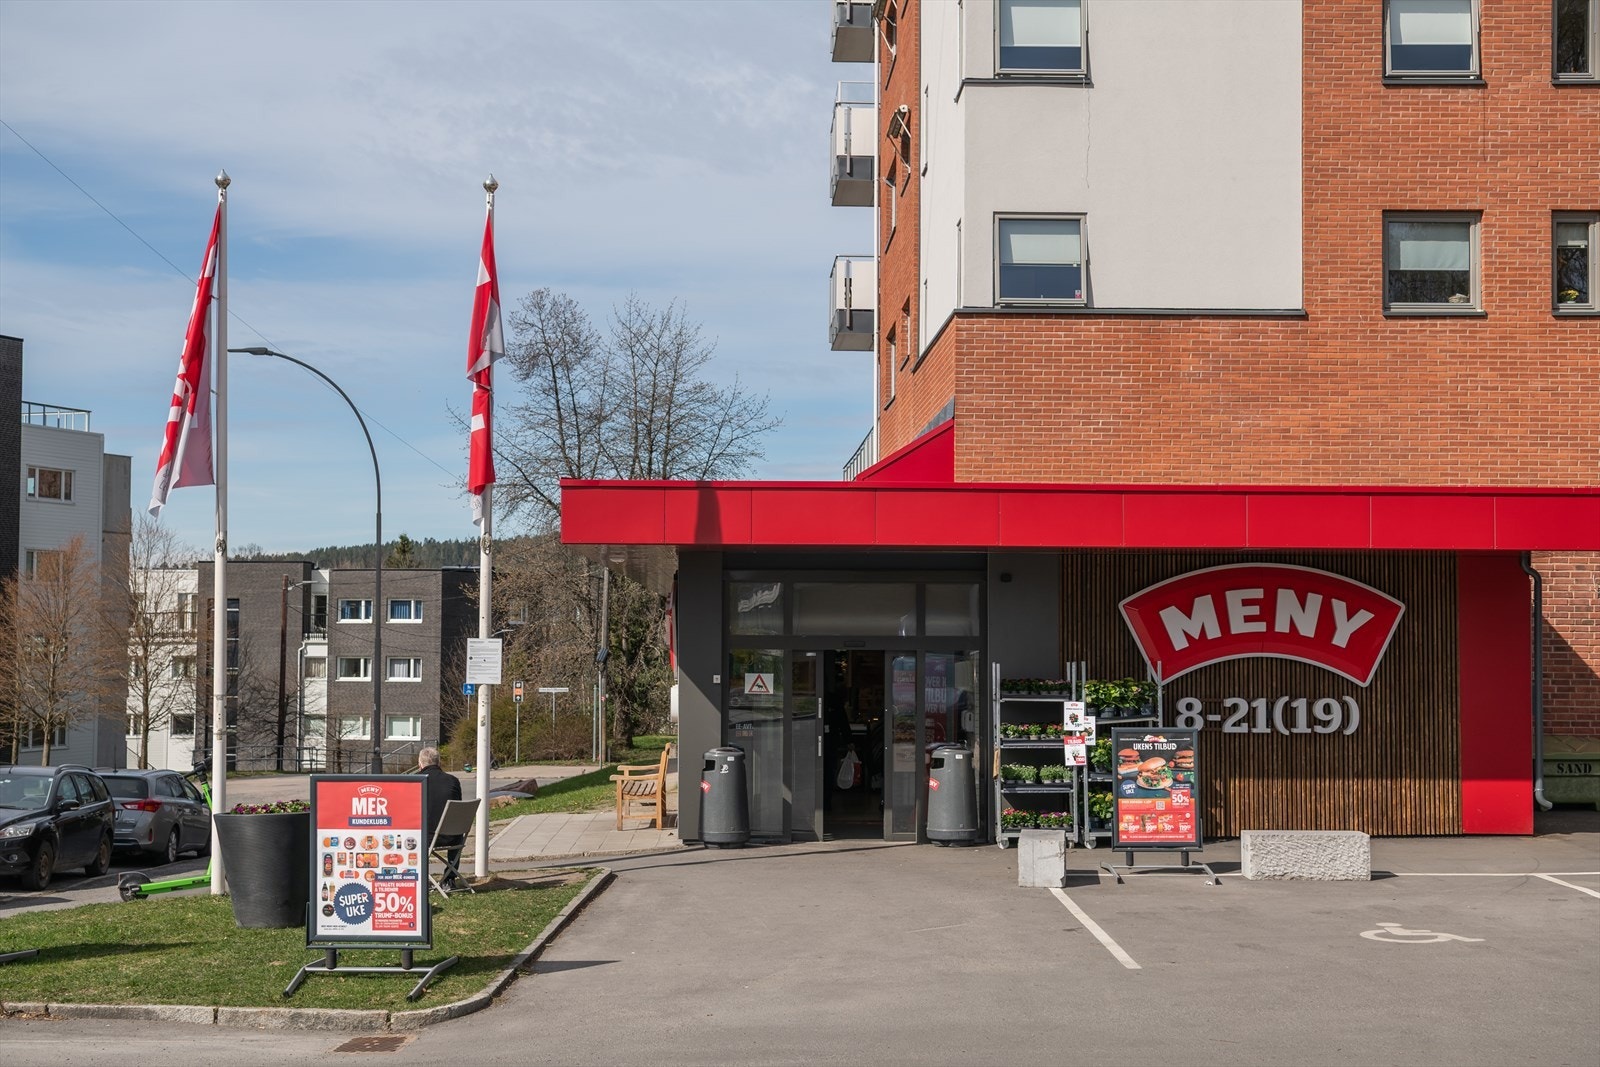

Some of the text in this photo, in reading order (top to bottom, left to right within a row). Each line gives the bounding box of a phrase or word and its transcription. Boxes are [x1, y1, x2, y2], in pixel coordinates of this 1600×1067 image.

[1159, 588, 1375, 651] MENY
[1176, 696, 1360, 735] 8-21(19)
[1556, 762, 1592, 774] SAND
[1172, 794, 1190, 803] 50%
[352, 798, 388, 815] MER
[339, 893, 369, 907] SUPER
[375, 893, 414, 912] 50%
[346, 905, 366, 917] UKE
